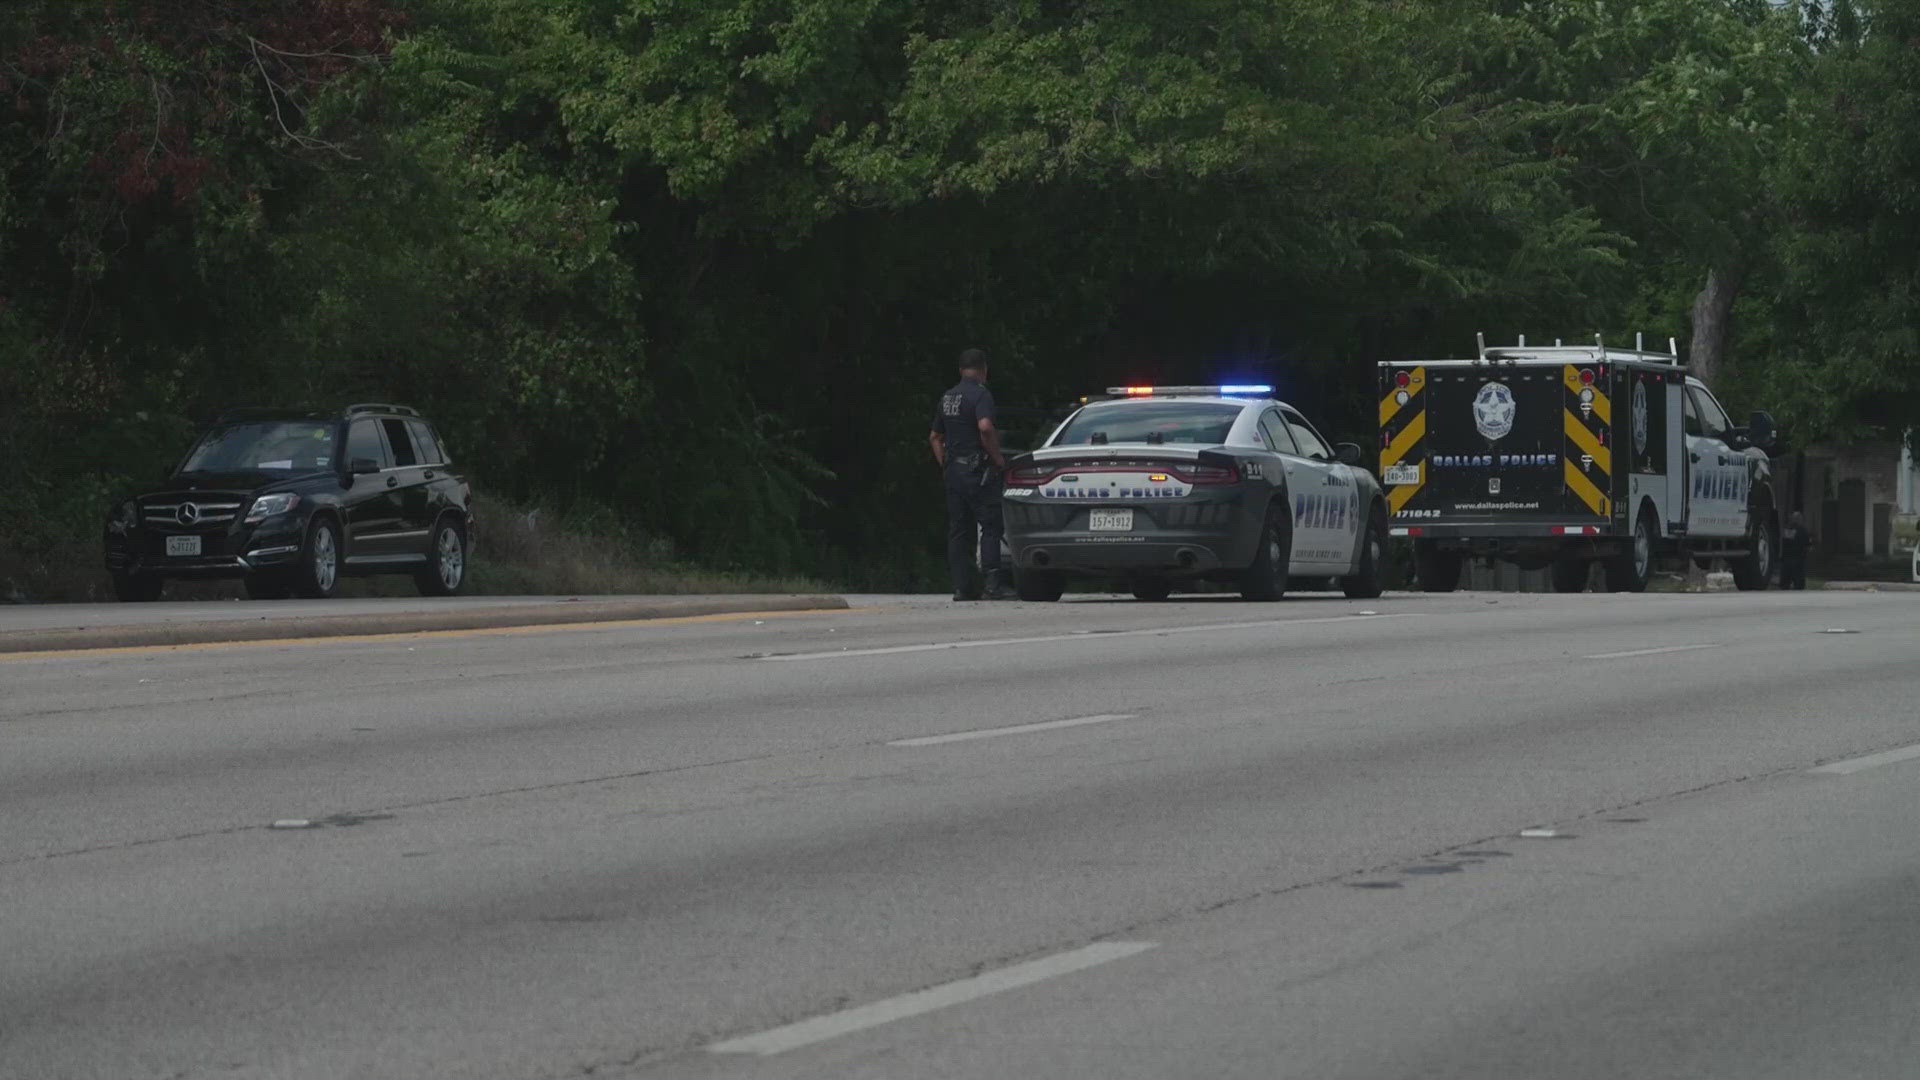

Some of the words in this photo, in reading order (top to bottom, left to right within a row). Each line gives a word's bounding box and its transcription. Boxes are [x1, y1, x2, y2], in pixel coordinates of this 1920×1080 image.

[1433, 455, 1493, 466] DALLAS
[1499, 454, 1557, 466] POLICE
[1693, 470, 1740, 500] POLICE
[1045, 487, 1110, 498] DALLAS
[1119, 487, 1184, 498] POLICE
[1295, 493, 1346, 529] POLICE
[1454, 501, 1540, 511] www.dallaspolice.net
[1396, 510, 1442, 518] 171042
[1075, 536, 1145, 544] www.dallaspolice.net
